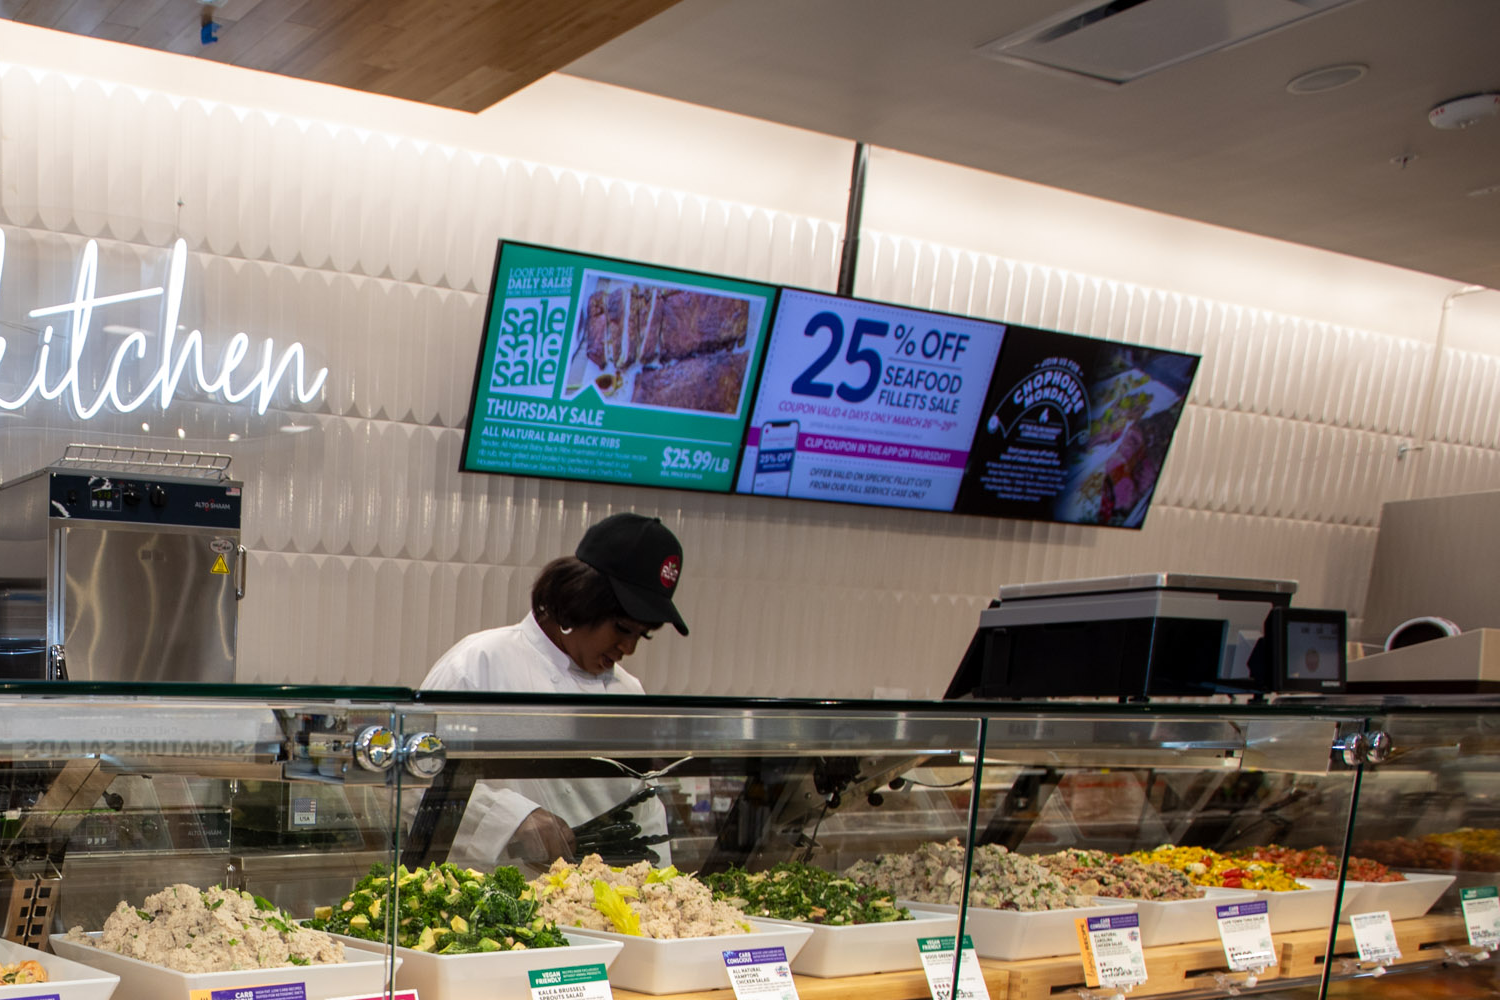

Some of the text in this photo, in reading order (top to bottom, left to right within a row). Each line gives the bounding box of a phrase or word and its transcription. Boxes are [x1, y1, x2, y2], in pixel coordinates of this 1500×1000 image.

[508, 277, 572, 289] DAILY SALES
[509, 266, 574, 278] LOOK FOR THE
[501, 299, 566, 335] sale
[497, 333, 560, 359] sale
[922, 329, 970, 363] OFF
[492, 359, 557, 387] sale
[883, 365, 962, 394] SEAFOOD
[877, 389, 960, 414] FILLETS SALE
[1013, 371, 1084, 414] CHOPHOUSE
[1024, 387, 1073, 414] MONDAYS
[487, 398, 605, 426] THURSDAY SALE
[482, 426, 620, 448] ALL NATURAL BABY BACK RIBS
[805, 437, 951, 462] CLIP COUPON IN THE APP ON THURSDAY!
[661, 446, 730, 473] $25.99/LB
[535, 976, 561, 985] FRIENDLY
[235, 991, 253, 999] CARB
